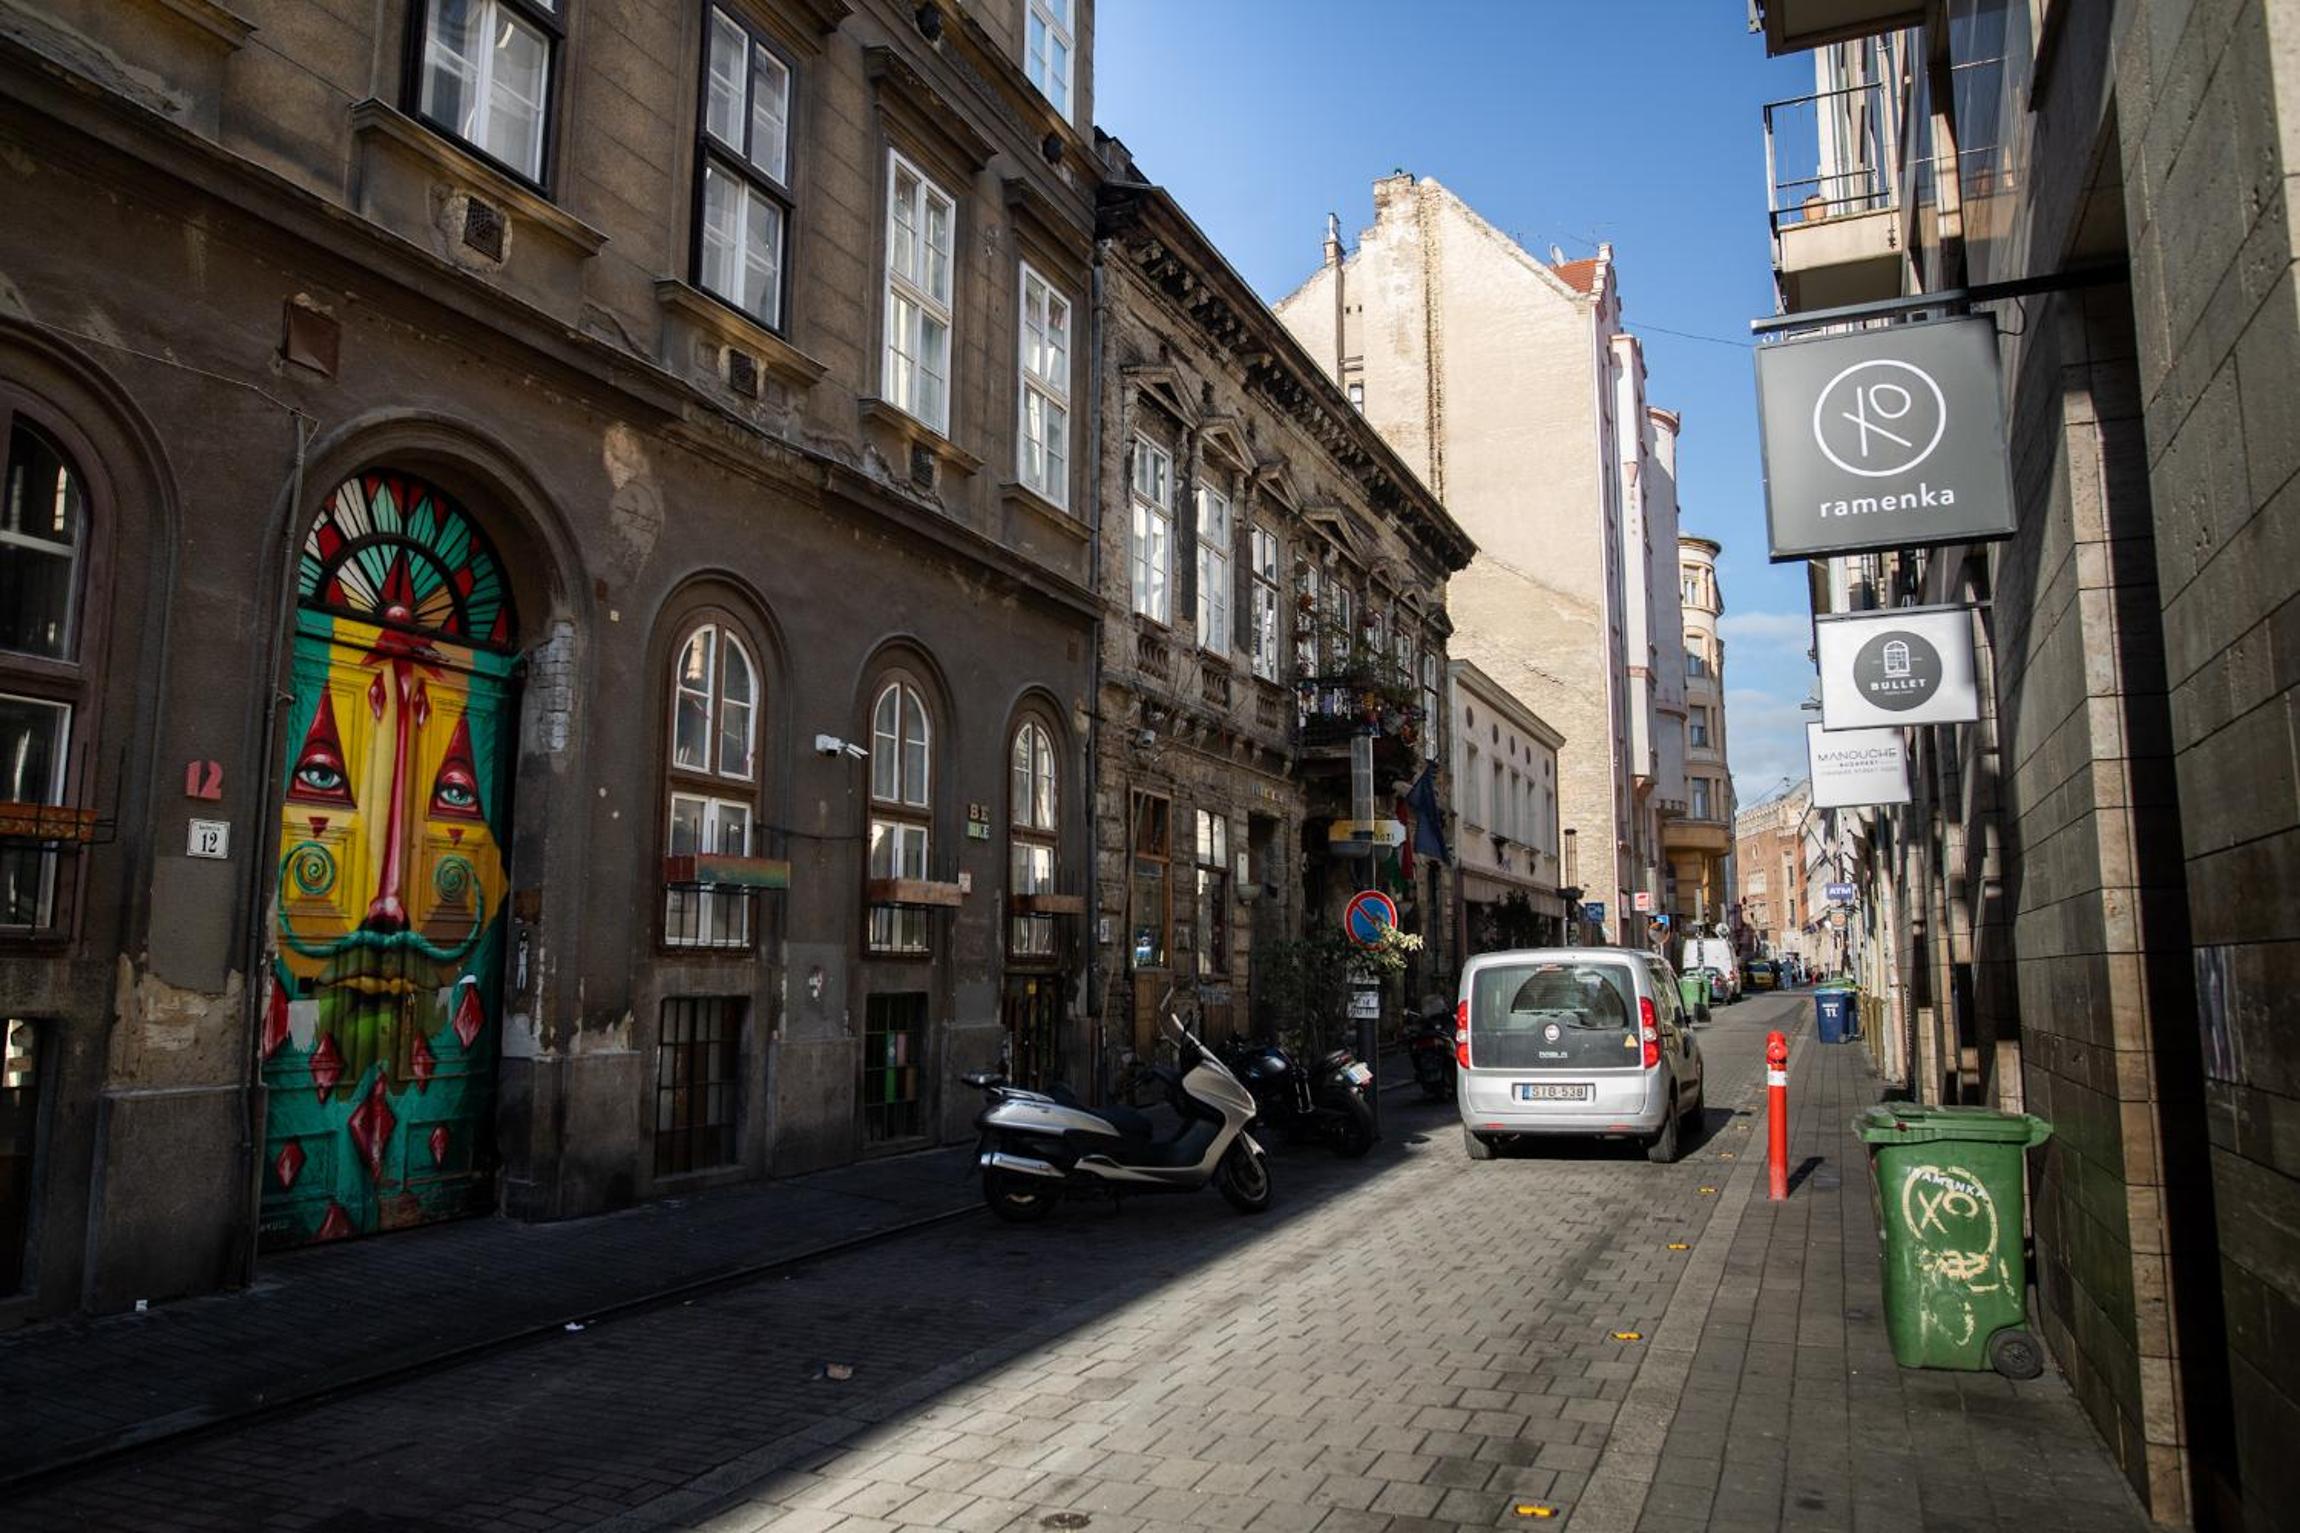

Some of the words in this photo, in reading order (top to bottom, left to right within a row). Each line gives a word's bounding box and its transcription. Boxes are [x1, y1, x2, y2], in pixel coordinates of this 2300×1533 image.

[1820, 483, 1955, 517] ramenka
[1870, 678, 1927, 691] BULLET
[1818, 747, 1896, 761] MANOUCHE
[186, 760, 223, 800] 12
[970, 803, 989, 821] BE
[202, 832, 217, 852] 12
[1829, 887, 1851, 895] ATM
